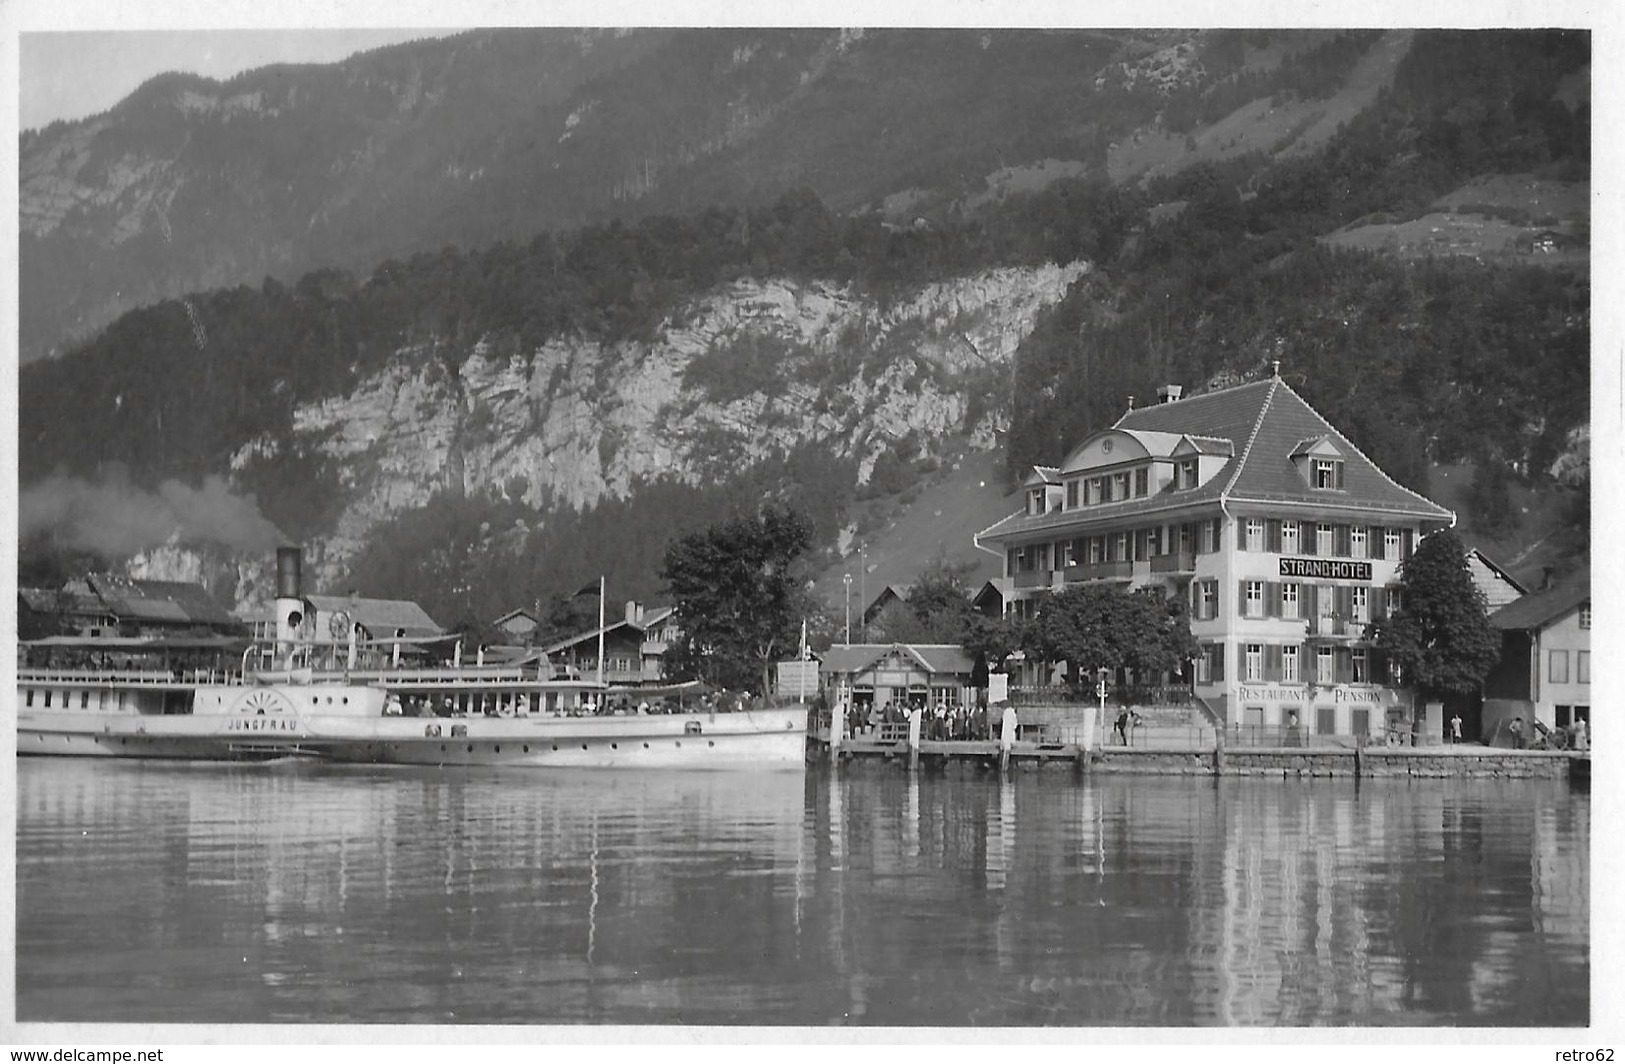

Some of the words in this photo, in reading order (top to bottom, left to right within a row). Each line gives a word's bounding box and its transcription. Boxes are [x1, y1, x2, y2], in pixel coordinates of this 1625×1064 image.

[1239, 687, 1306, 700] RESTAURANT
[1335, 689, 1381, 703] PENSION
[228, 719, 296, 730] JUNGFRAU
